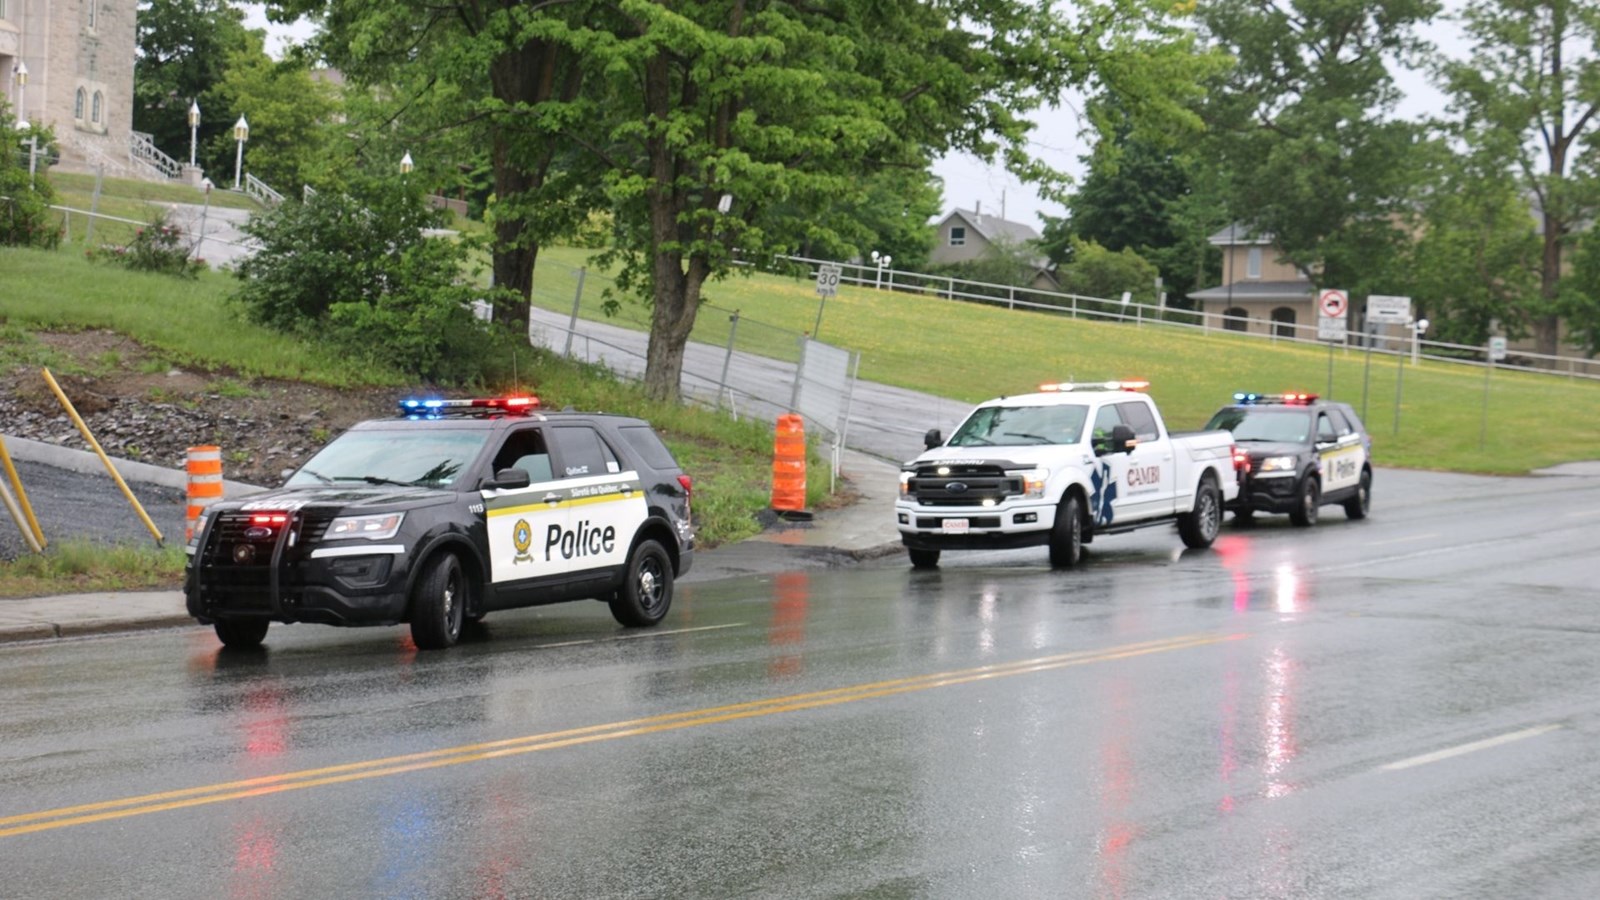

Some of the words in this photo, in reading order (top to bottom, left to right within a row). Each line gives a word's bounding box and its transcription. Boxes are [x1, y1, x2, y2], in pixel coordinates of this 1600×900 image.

[819, 273, 838, 286] 30
[1127, 465, 1160, 487] CAMBI
[590, 486, 598, 495] du
[598, 484, 618, 494] Québec
[468, 503, 484, 514] 1113
[545, 520, 615, 561] Police
